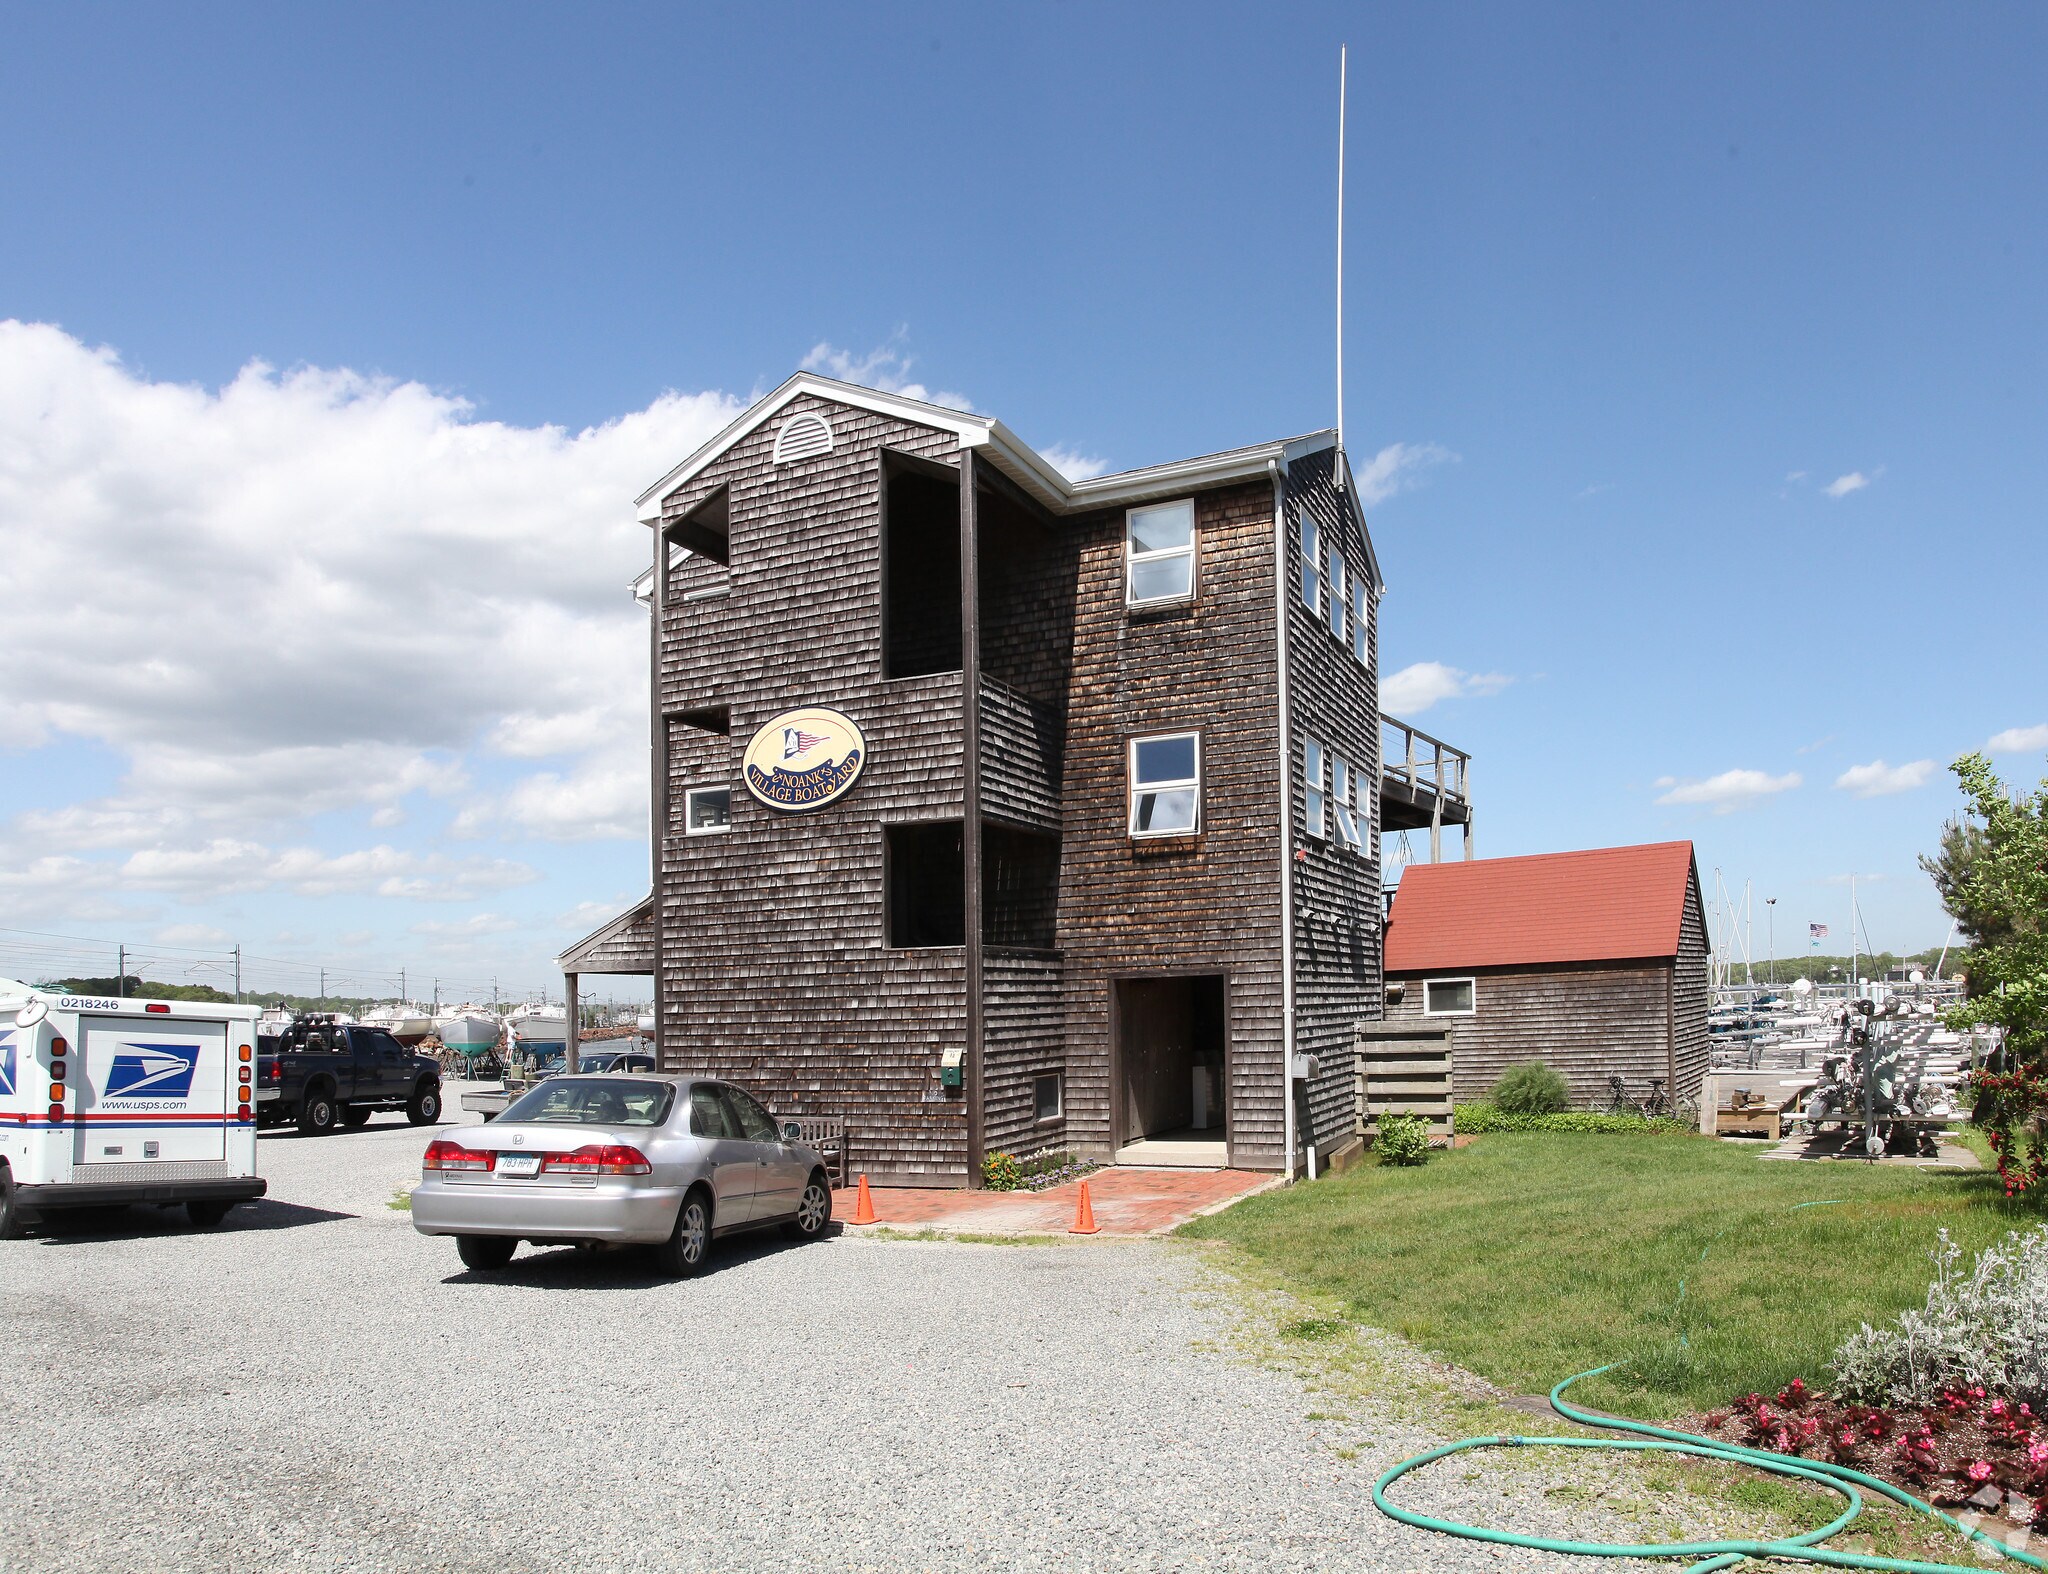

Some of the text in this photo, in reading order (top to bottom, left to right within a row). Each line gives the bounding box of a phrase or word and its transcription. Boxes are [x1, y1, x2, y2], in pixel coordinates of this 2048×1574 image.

[750, 768, 792, 801] VILLAGE
[61, 997, 119, 1010] 0218246
[101, 1099, 187, 1112] www.usps.com
